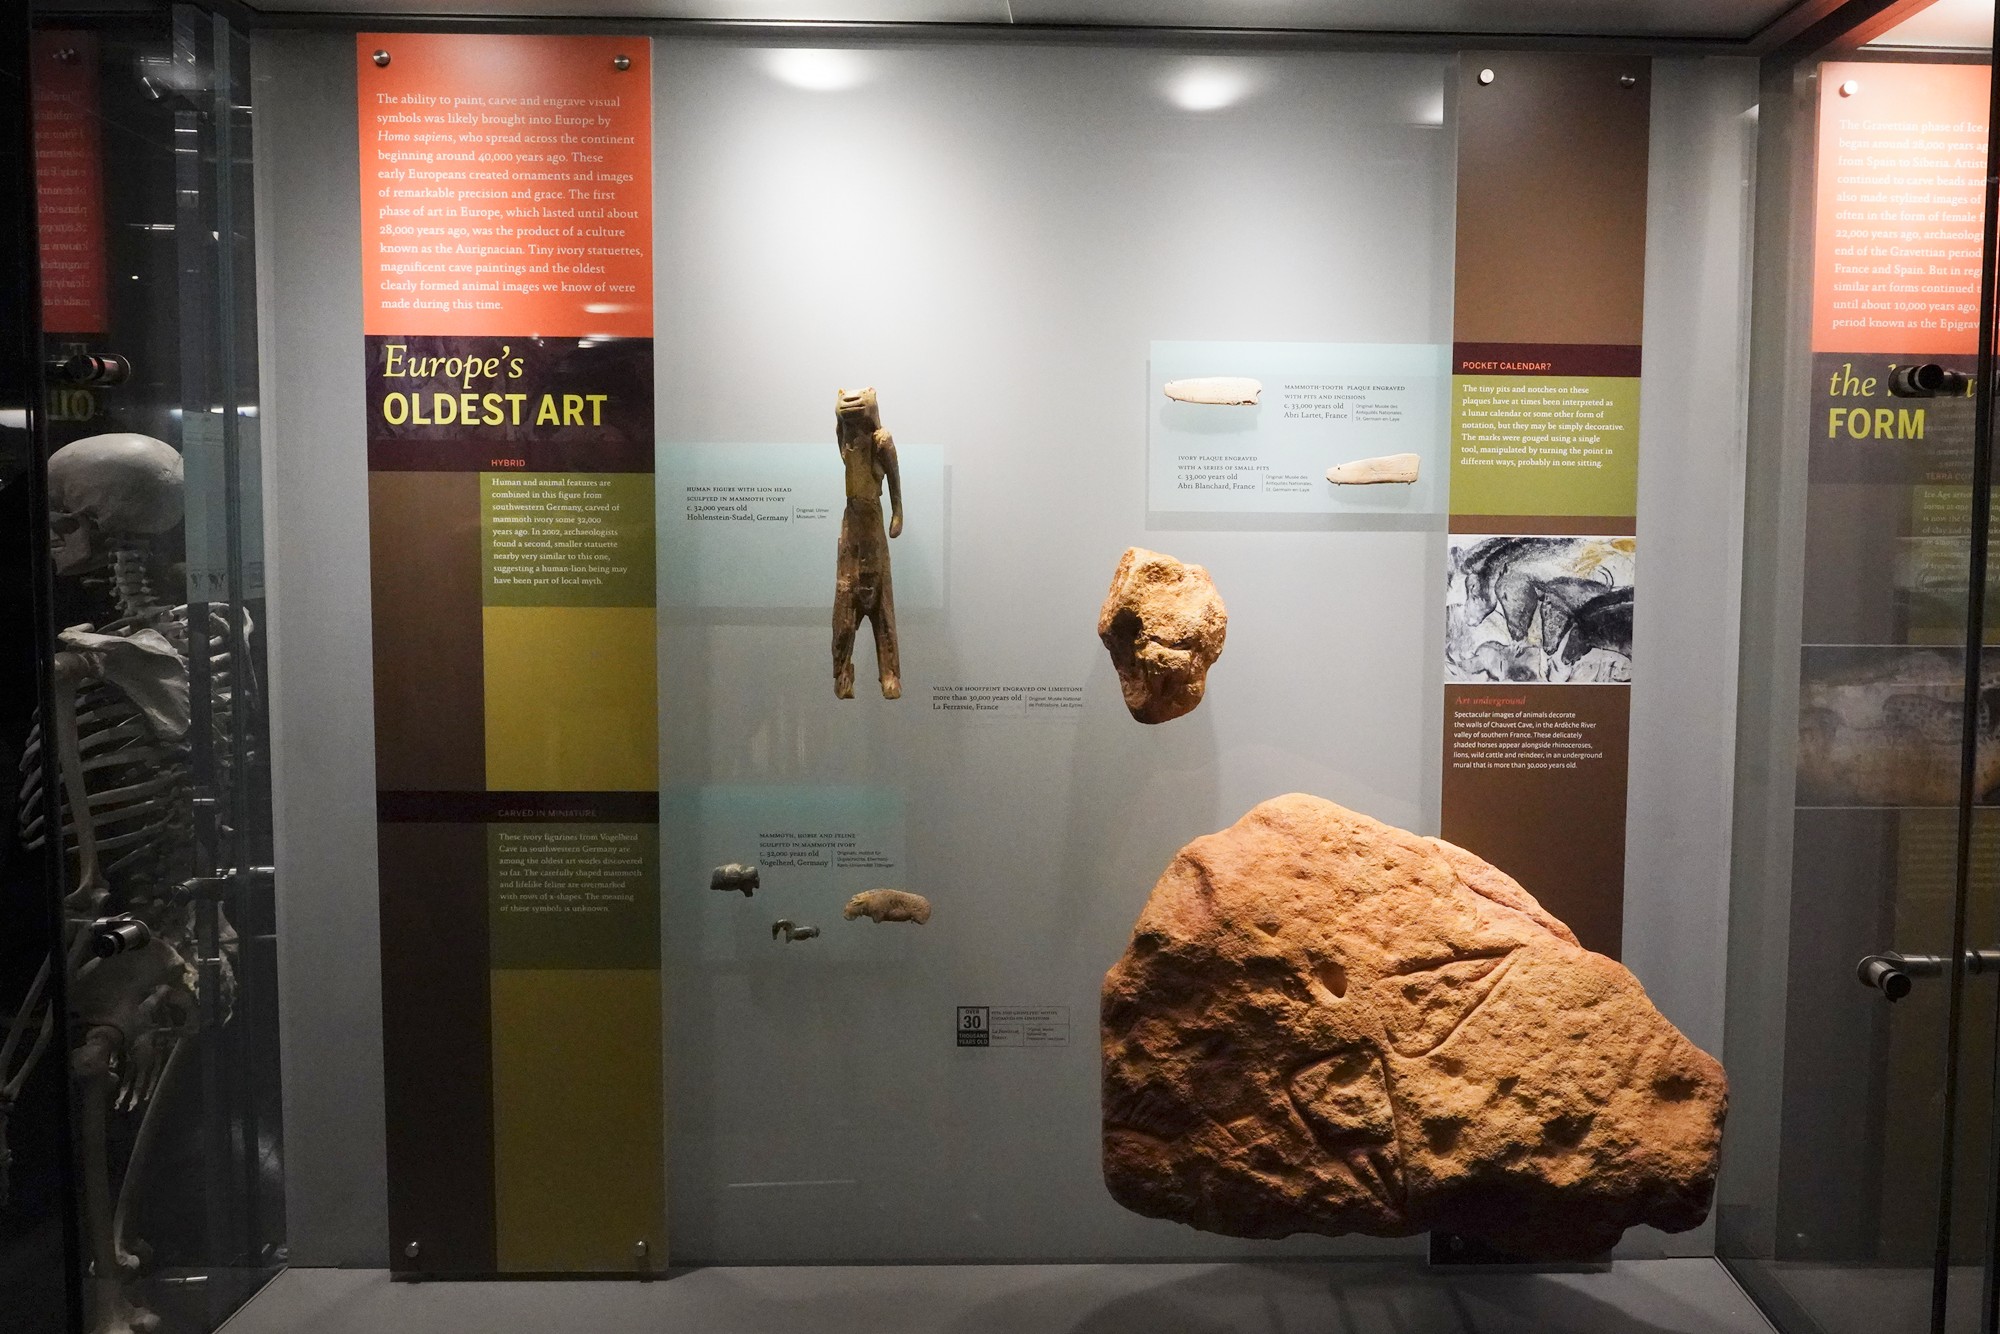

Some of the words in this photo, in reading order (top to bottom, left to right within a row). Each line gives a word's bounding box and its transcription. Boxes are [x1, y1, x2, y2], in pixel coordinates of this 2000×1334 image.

[377, 93, 398, 104] The
[401, 94, 437, 107] ability
[439, 97, 451, 105] to
[454, 97, 486, 108] paint,
[520, 95, 540, 106] and
[543, 99, 586, 110] engrave
[589, 96, 620, 107] visual
[377, 112, 422, 125] symbols
[448, 113, 478, 126] likely
[481, 113, 526, 127] brought
[555, 115, 594, 128] Europe
[598, 115, 611, 128] by
[378, 130, 411, 142] Homo
[413, 134, 456, 145] sapiens,
[459, 132, 483, 142] who
[486, 132, 522, 146] spread
[560, 133, 578, 144] the
[581, 136, 635, 144] continent
[1835, 245, 1854, 256] end
[1857, 246, 1869, 256] of
[1871, 246, 1887, 256] the
[1890, 246, 1946, 257] Gravettian
[1948, 248, 1982, 260] period
[1835, 263, 1870, 274] France
[1872, 264, 1892, 274] and
[1894, 264, 1926, 278] Spain.
[1929, 265, 1948, 275] But
[1833, 299, 1859, 309] until
[1861, 299, 1891, 310] about
[1895, 302, 1927, 312] 10,000
[1929, 303, 1955, 313] years
[1957, 304, 1980, 315] ago,
[383, 345, 524, 389] Europe’s
[1462, 362, 1498, 370] POCKET
[1500, 362, 1552, 370] CALENDAR?
[1830, 363, 1876, 397] the
[1496, 386, 1511, 395] pits
[383, 393, 527, 425] OLDEST
[536, 394, 607, 426] ART
[1462, 397, 1491, 407] plaques
[1542, 398, 1561, 406] been
[1562, 398, 1604, 408] interpreted
[1829, 408, 1924, 439] FORM
[558, 491, 581, 501] figure
[546, 503, 583, 512] Germany,
[687, 514, 757, 522] Hohlenstein-Stadel,
[1456, 696, 1470, 704] Art
[1473, 696, 1526, 707] underground
[760, 859, 796, 869] Vogelherd,
[797, 859, 829, 868] Germany
[964, 1015, 981, 1029] 30
